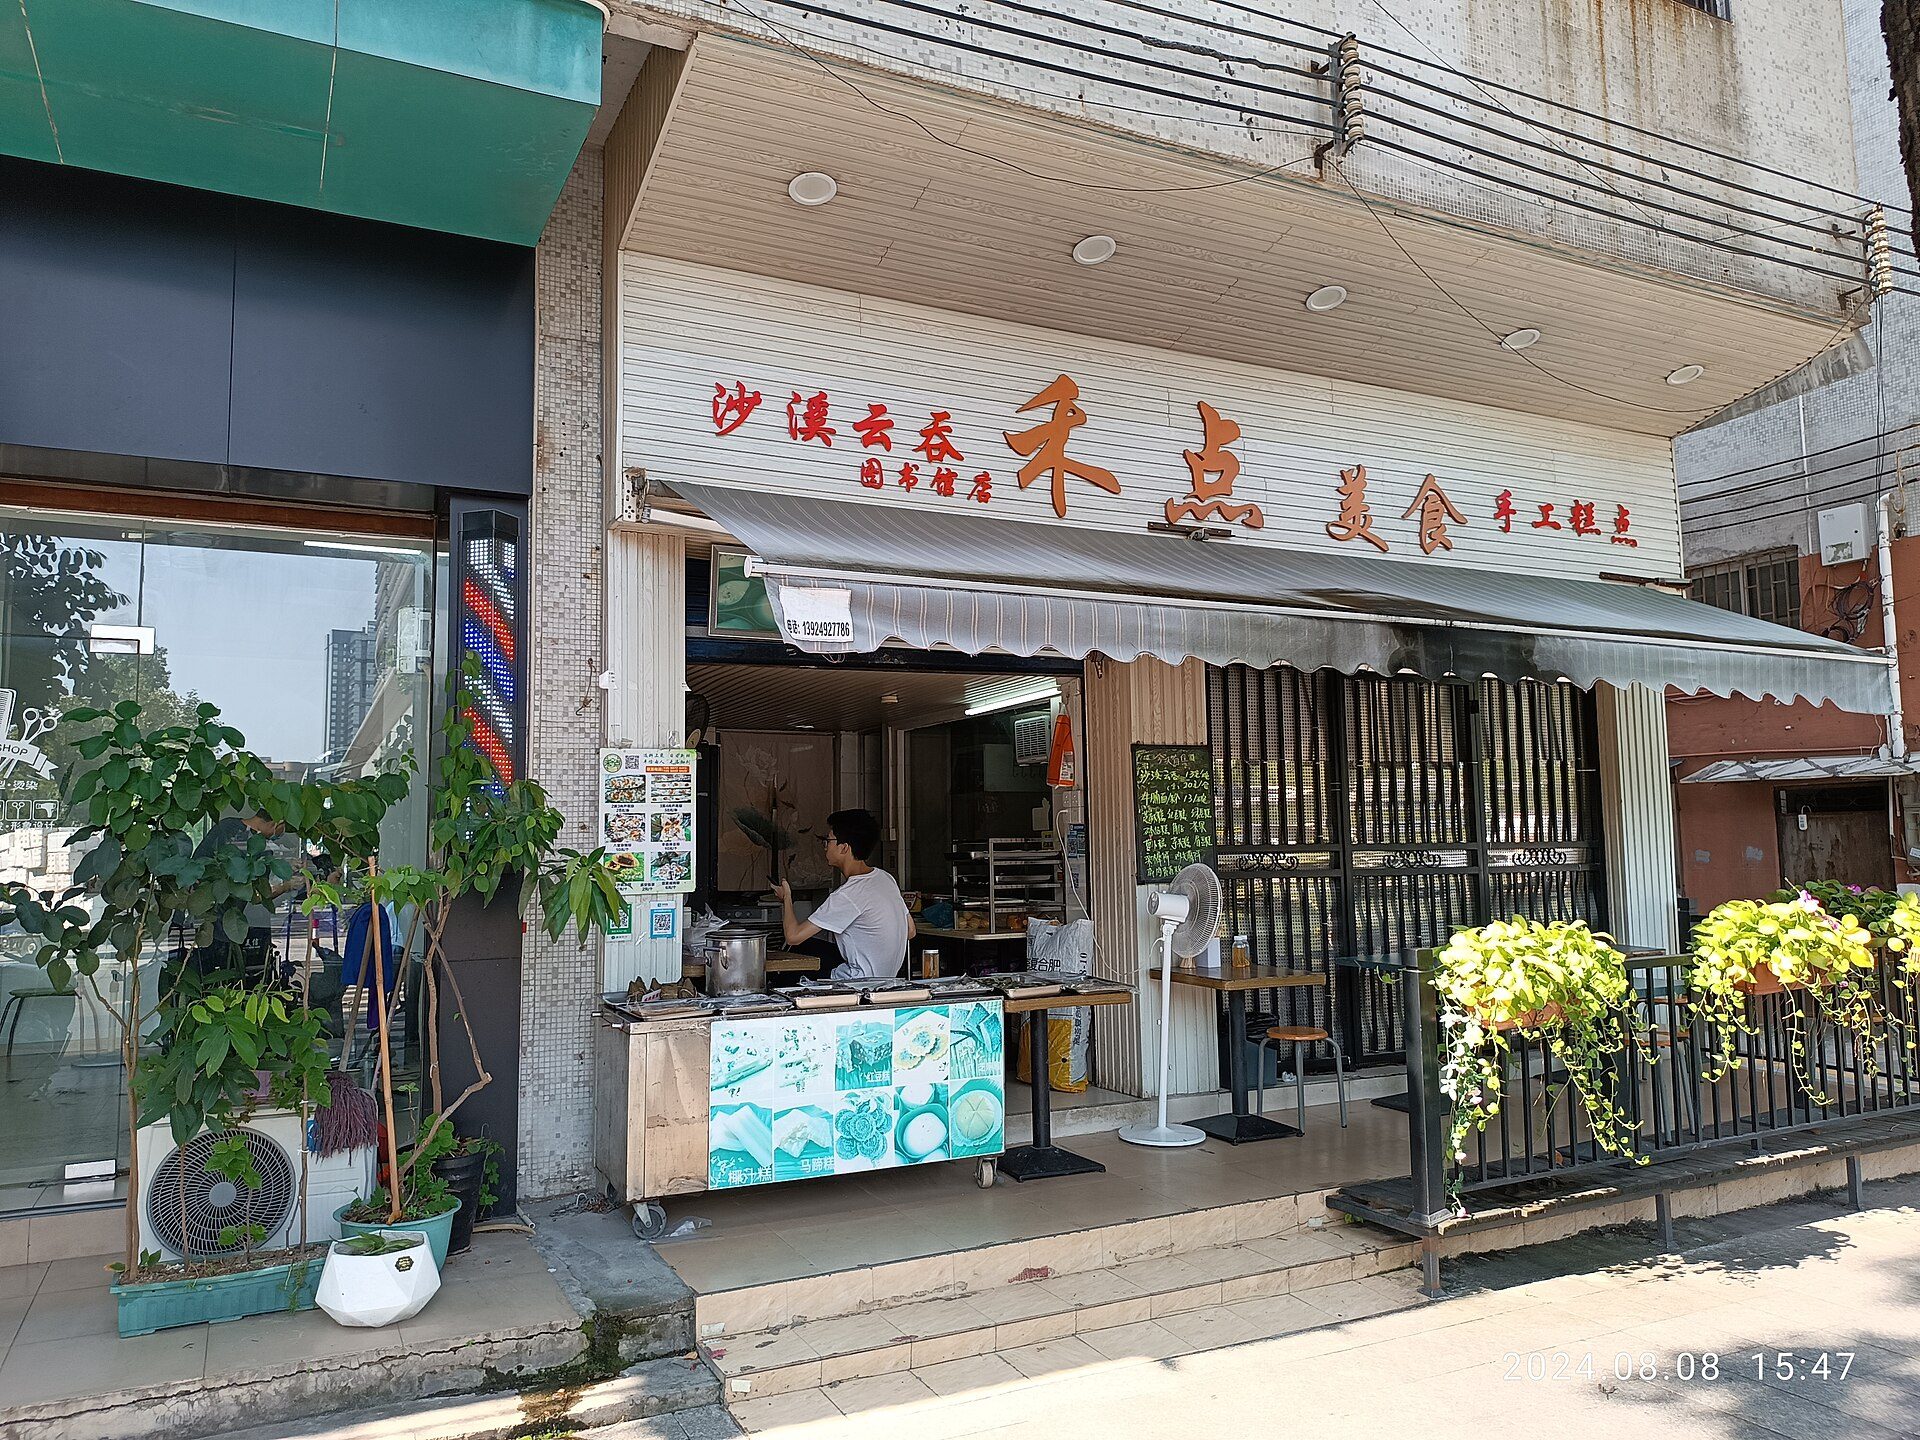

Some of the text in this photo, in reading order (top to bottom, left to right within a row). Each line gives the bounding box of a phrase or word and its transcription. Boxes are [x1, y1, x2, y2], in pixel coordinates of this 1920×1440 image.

[712, 380, 964, 463] 沙溪云吞
[860, 457, 993, 503] 图书馆店
[1003, 373, 1468, 555] 禾点美食
[1494, 489, 1638, 548] 手工糕点
[802, 620, 850, 637] 13924927786
[728, 1165, 772, 1186] 椰汁糕
